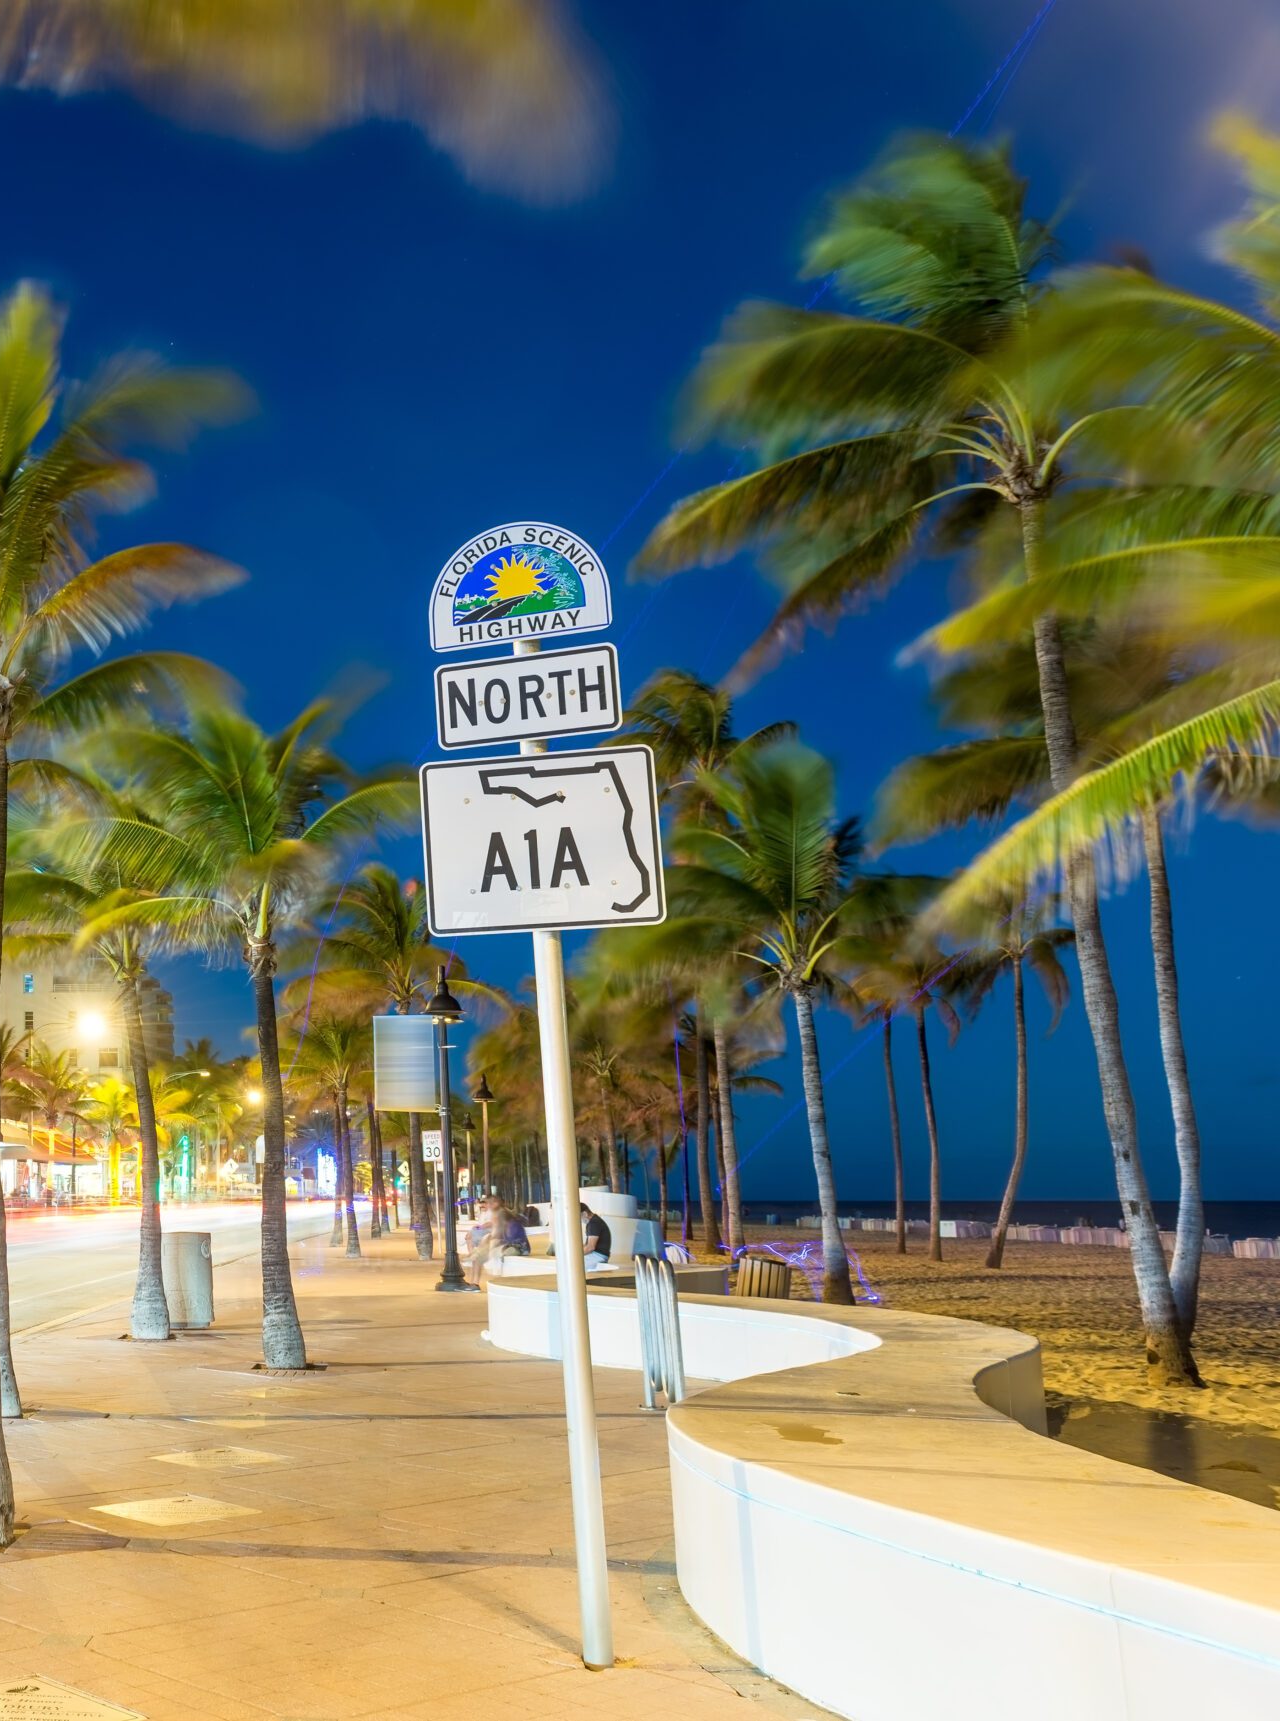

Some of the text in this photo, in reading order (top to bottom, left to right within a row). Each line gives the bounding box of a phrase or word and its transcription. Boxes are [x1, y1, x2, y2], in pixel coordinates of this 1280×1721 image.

[439, 527, 595, 598] FLORIDA SCENIC
[459, 610, 581, 642] HIGHWAY
[447, 665, 608, 729] NORTH
[480, 826, 590, 893] A1A
[426, 1147, 440, 1157] 30
